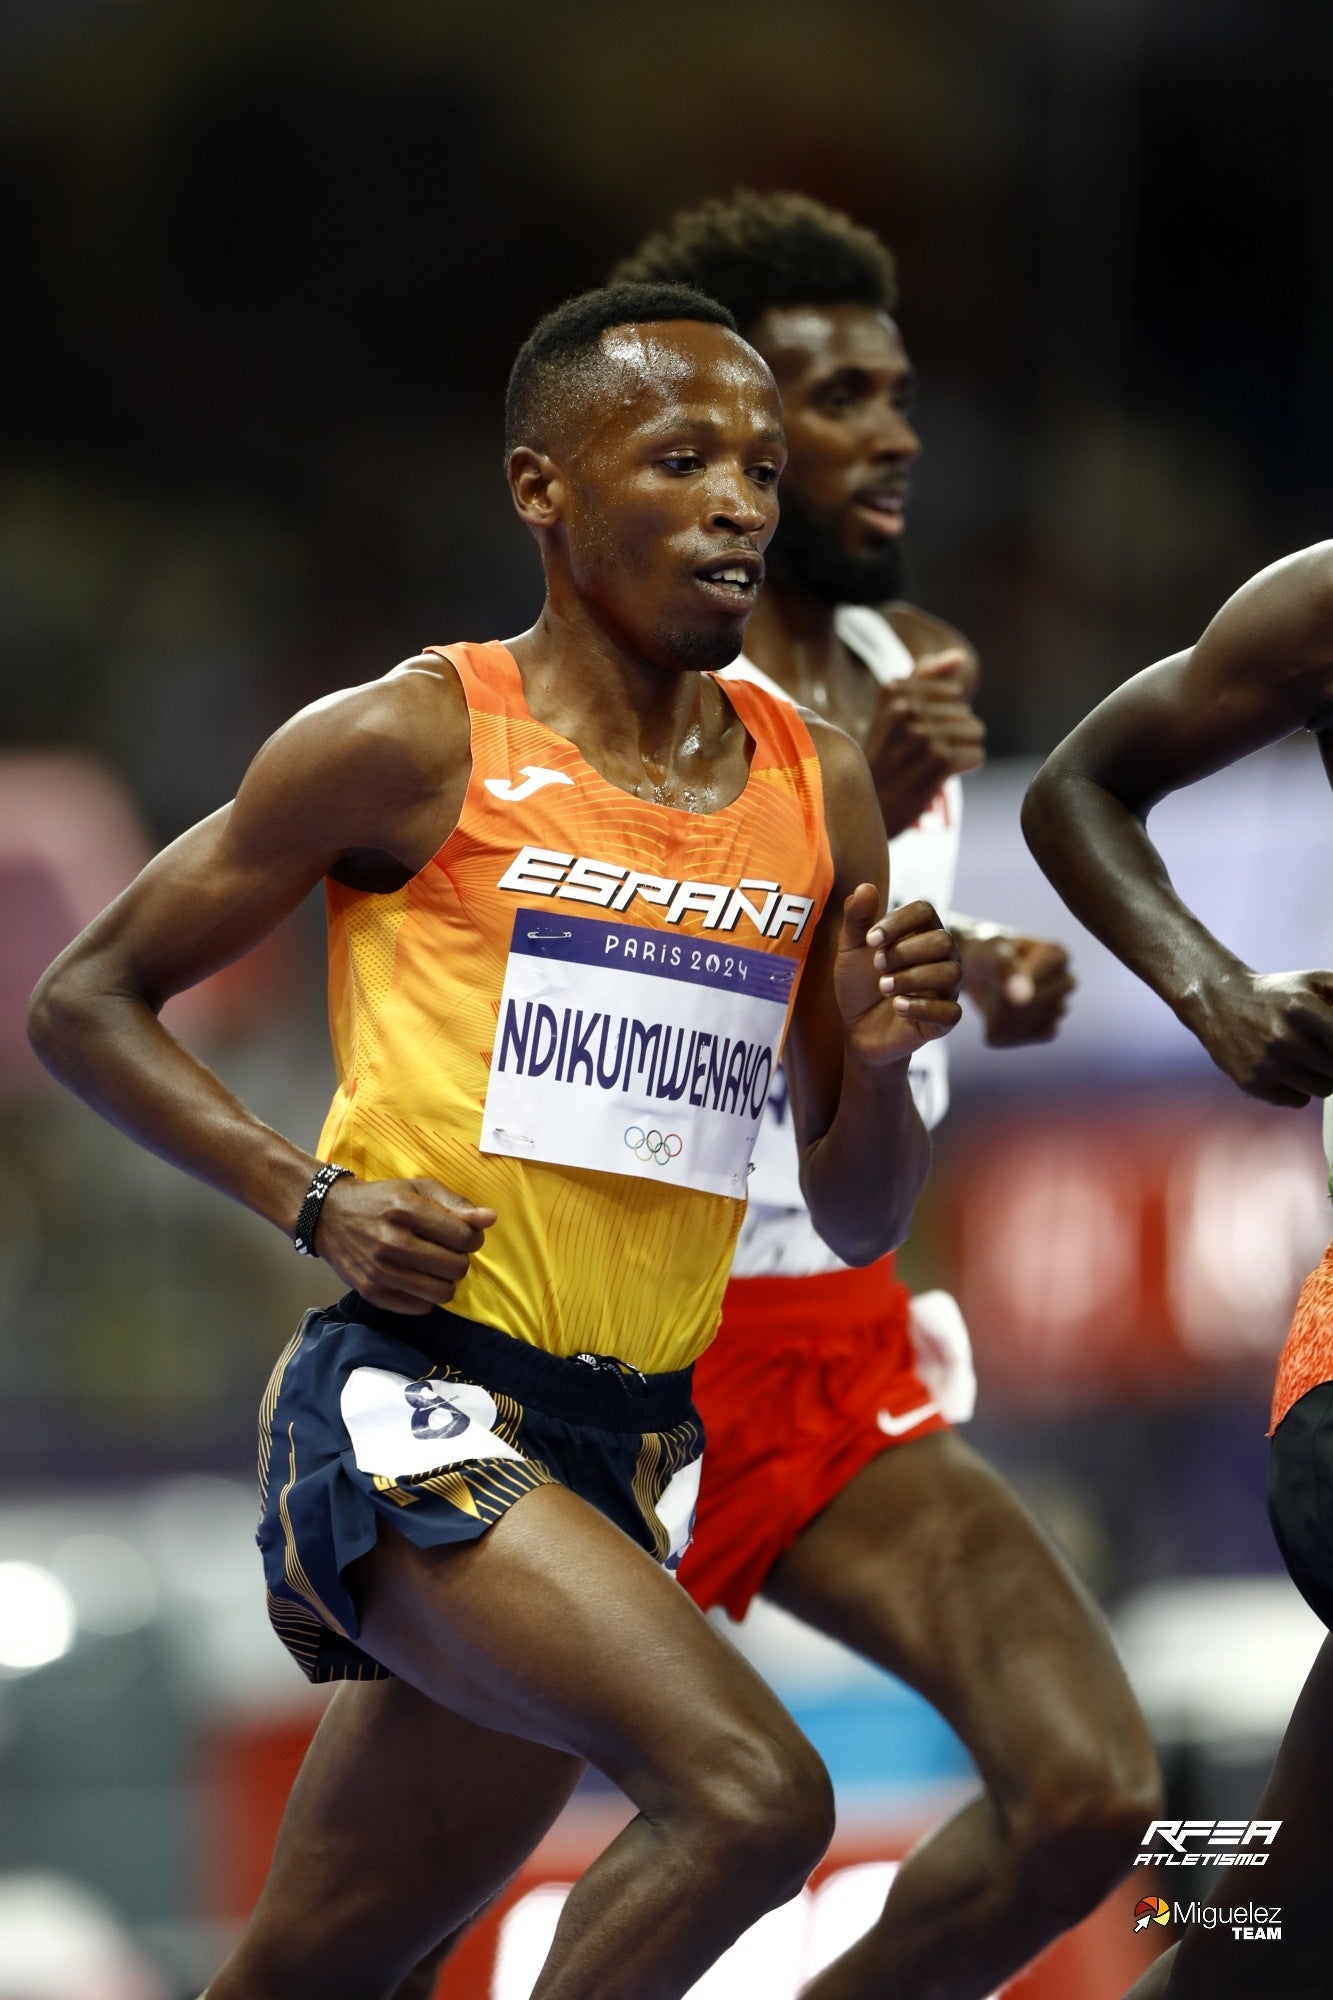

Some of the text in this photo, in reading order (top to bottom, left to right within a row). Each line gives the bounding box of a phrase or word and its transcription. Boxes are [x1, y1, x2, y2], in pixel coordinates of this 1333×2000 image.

[497, 846, 815, 942] ESPAÑA
[690, 951, 748, 981] 2024
[498, 998, 773, 1121] NDIKUMWENAYO
